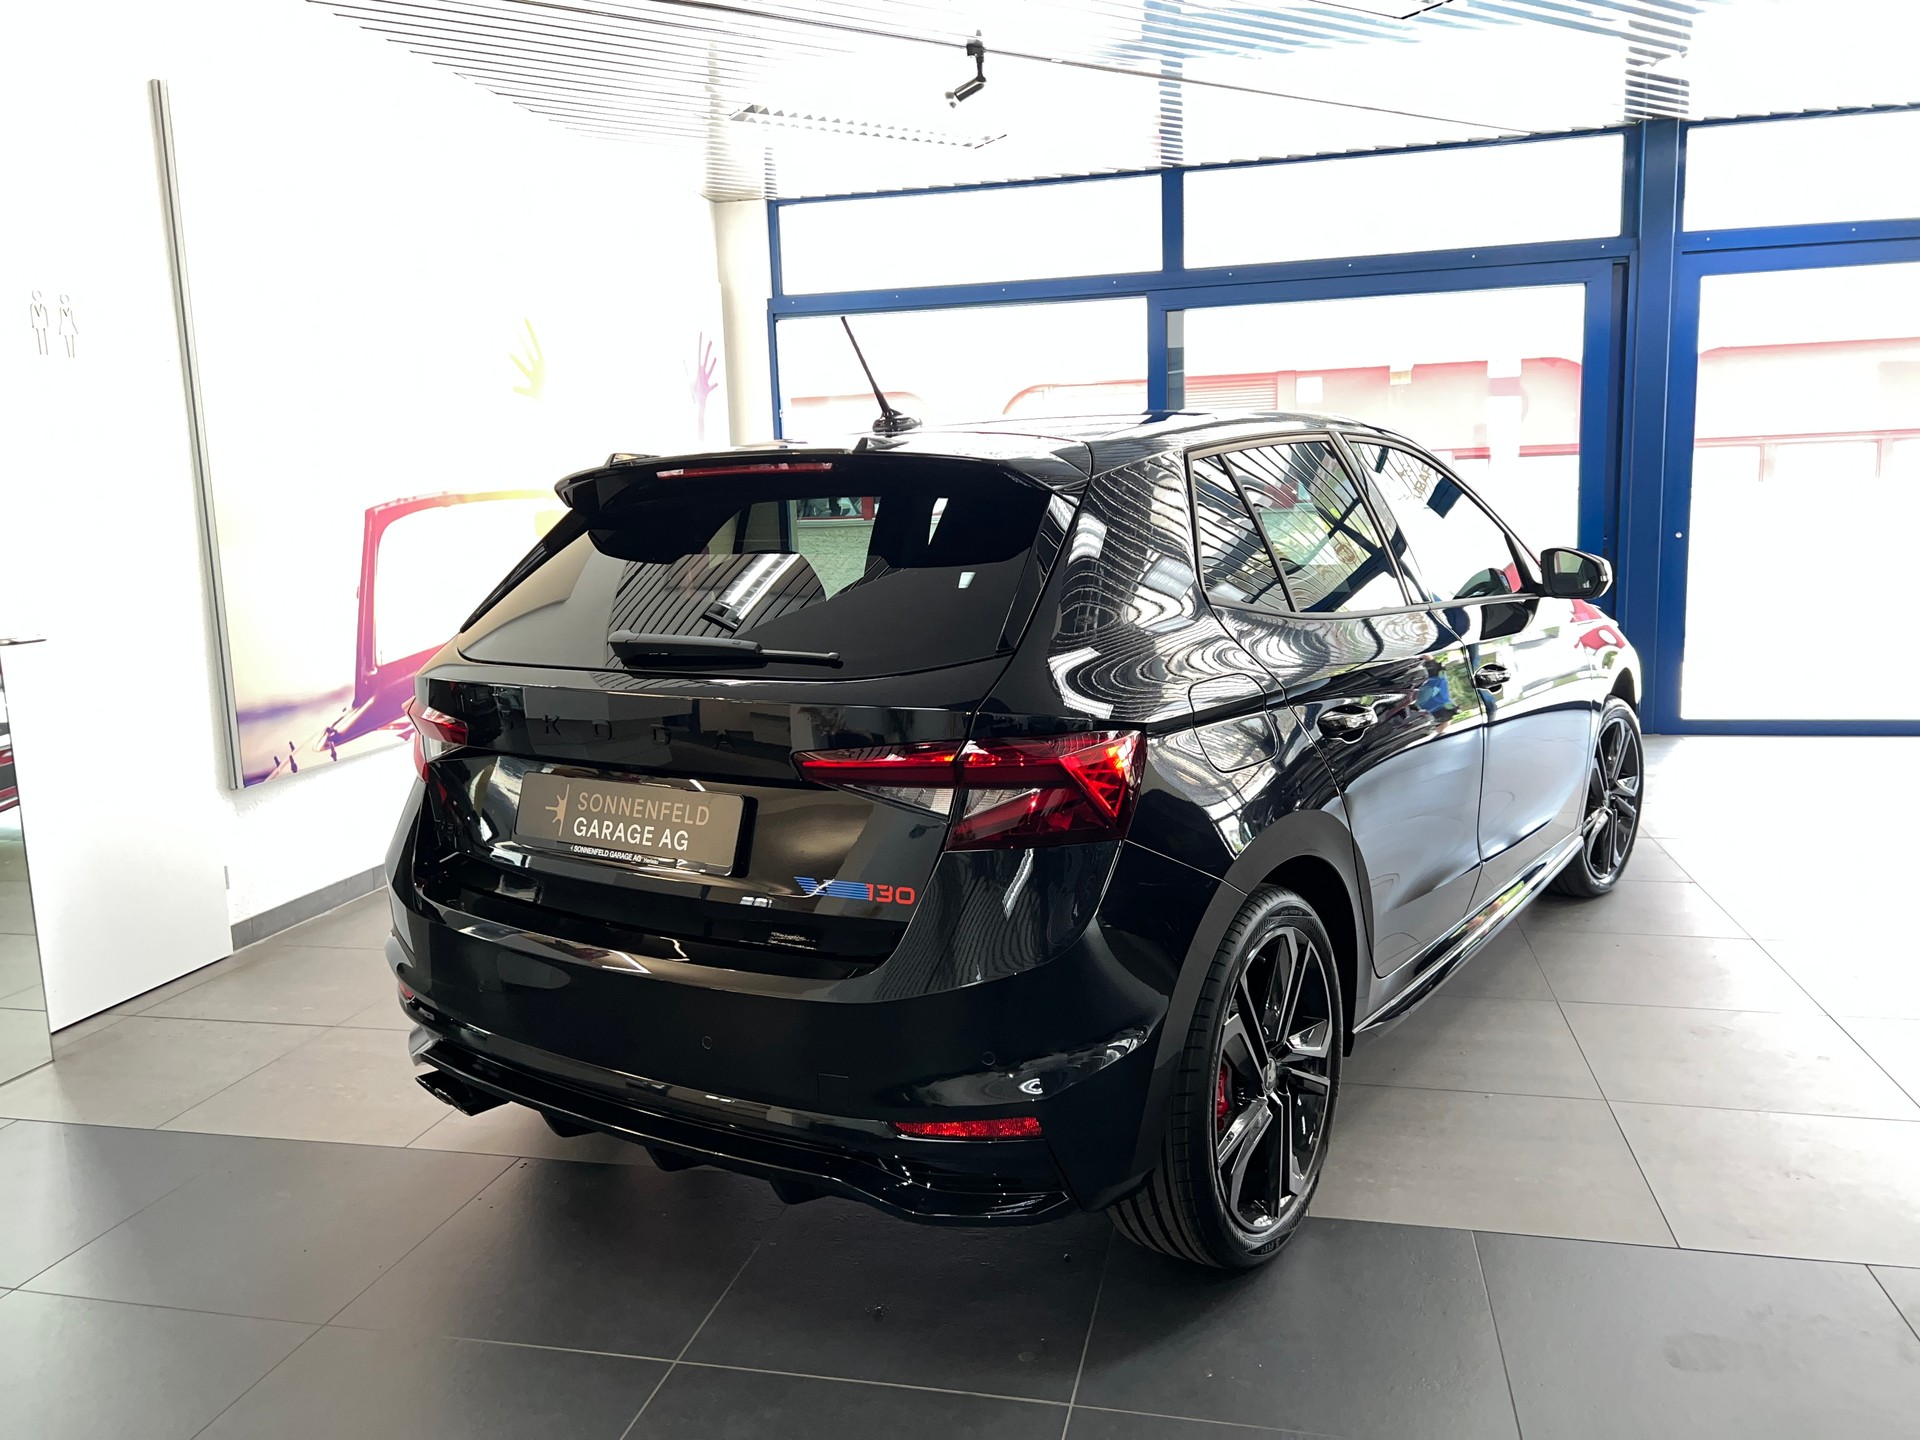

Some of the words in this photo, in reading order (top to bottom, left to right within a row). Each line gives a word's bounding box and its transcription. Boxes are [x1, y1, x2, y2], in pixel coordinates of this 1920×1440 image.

[577, 791, 711, 827] SONNENFELD
[573, 816, 656, 847] GARAGE
[658, 828, 690, 852] AG
[573, 844, 609, 858] SONNENFELD
[609, 850, 632, 861] GARAGE
[632, 855, 642, 863] AG
[865, 883, 916, 905] 130
